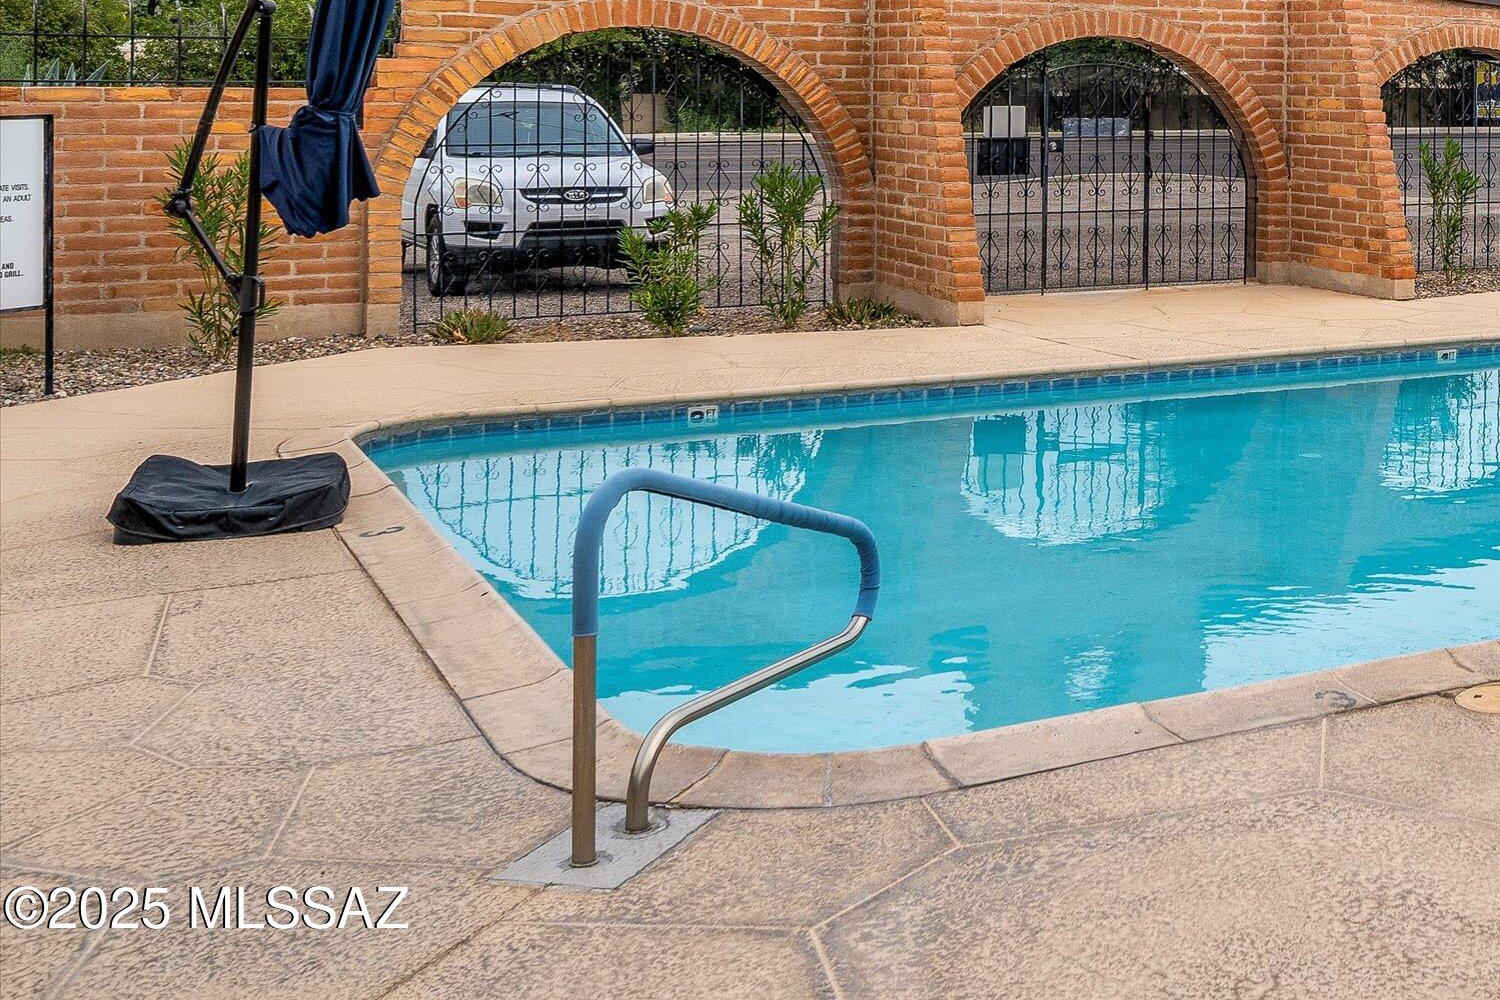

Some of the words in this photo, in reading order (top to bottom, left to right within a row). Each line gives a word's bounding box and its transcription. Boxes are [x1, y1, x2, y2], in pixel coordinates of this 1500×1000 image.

[2, 195, 12, 203] AN
[13, 194, 31, 202] ADULT
[2, 262, 14, 270] AND
